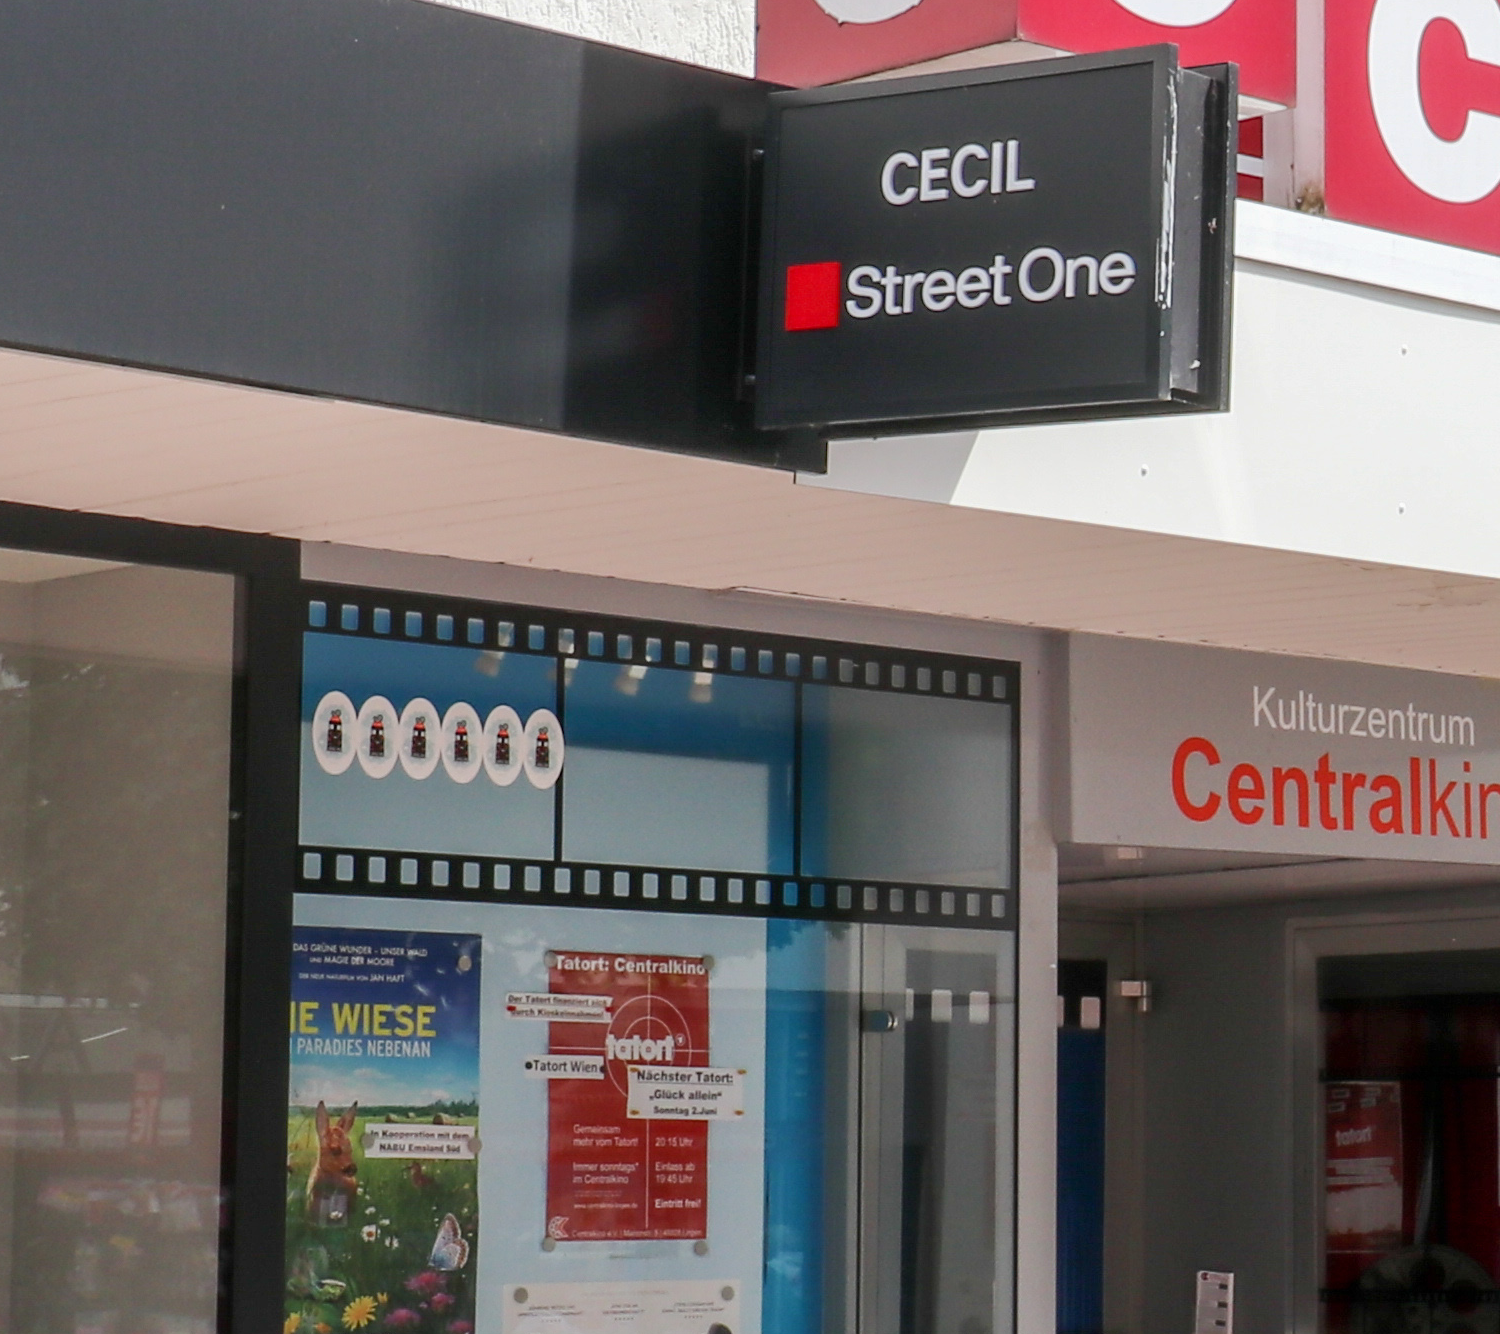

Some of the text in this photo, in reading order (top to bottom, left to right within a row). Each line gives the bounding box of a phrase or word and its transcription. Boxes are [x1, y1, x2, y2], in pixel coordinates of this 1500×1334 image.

[881, 139, 1036, 206] CECIL
[845, 247, 1137, 319] Street One
[1252, 685, 1476, 747] Kulturzentrum
[311, 942, 337, 953] GRÜNE
[339, 945, 371, 955] WUNDER
[381, 947, 404, 956] UNSER
[407, 948, 428, 957] WALD
[324, 956, 394, 967] MAGIE DER MOORE
[555, 955, 609, 972] Tatort:
[369, 974, 385, 982] JAN
[386, 974, 404, 983] HAFT
[525, 995, 551, 1005] Tatort
[290, 1001, 436, 1038] IE WIESE
[297, 1038, 431, 1058] PARADIES NEBENAN
[606, 1034, 675, 1061] tatort
[533, 1060, 598, 1073] Tatort Wien
[637, 1071, 734, 1083] Nächster Tatort:
[653, 1106, 689, 1117] Sonntag
[382, 1130, 435, 1139] Kooperation
[573, 1124, 621, 1135] Gemeinsam
[380, 1143, 405, 1151] NABU
[685, 1162, 695, 1171] ab
[584, 1175, 629, 1184] Centralkino
[655, 1199, 683, 1209] Eintritt
